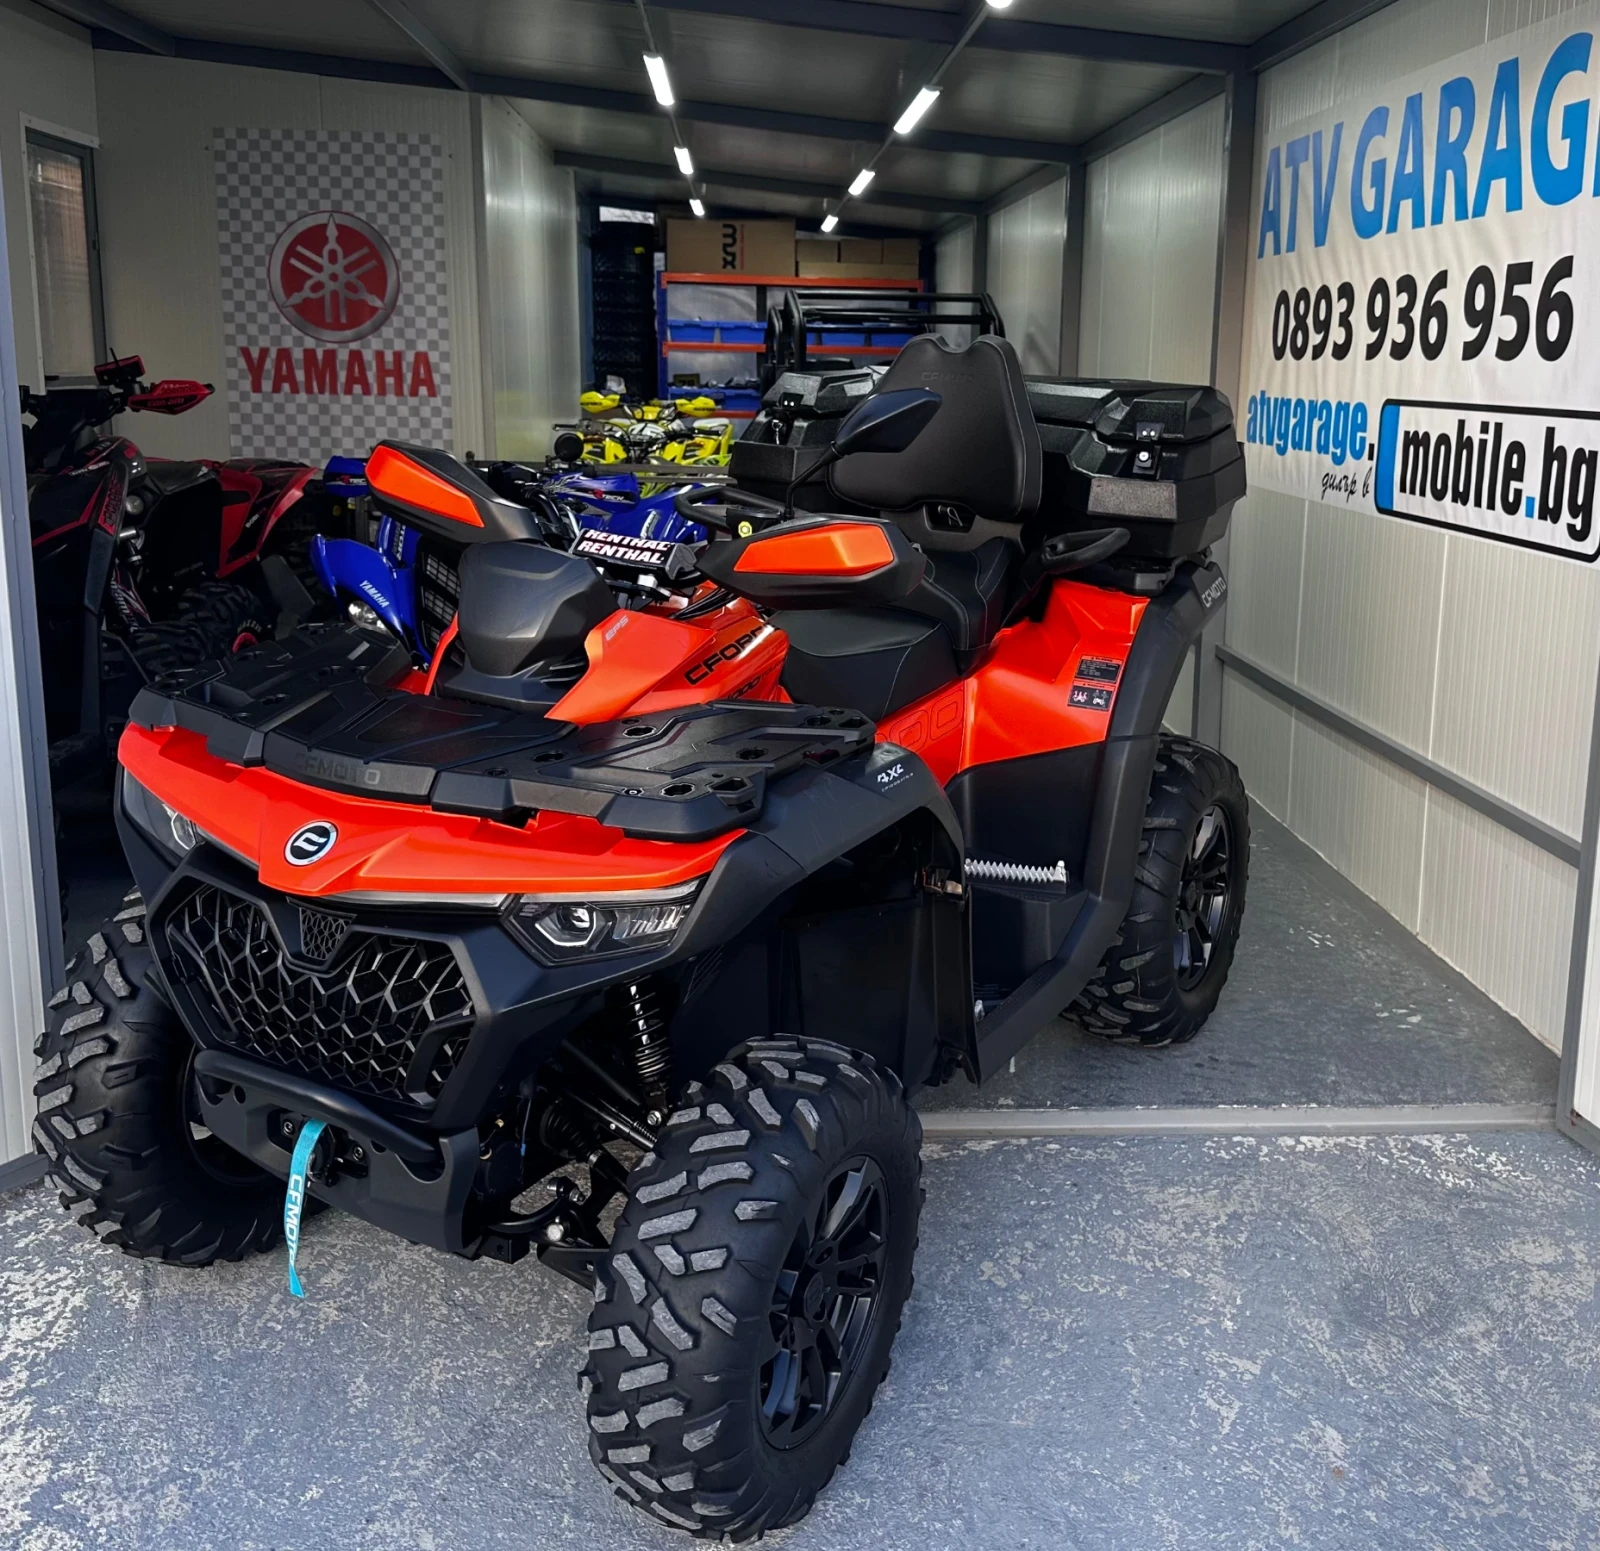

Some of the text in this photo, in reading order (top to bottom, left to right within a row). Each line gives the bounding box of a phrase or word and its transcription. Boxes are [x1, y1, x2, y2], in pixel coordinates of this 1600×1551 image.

[1257, 32, 1600, 259] ATV GARAG
[1272, 255, 1574, 361] 0893 936 956
[239, 347, 437, 398] YAMAHA
[1399, 418, 1599, 542] mobile.bg
[577, 541, 665, 564] RENTHAL
[360, 580, 390, 608] YAMAHA
[605, 614, 629, 642] EPS
